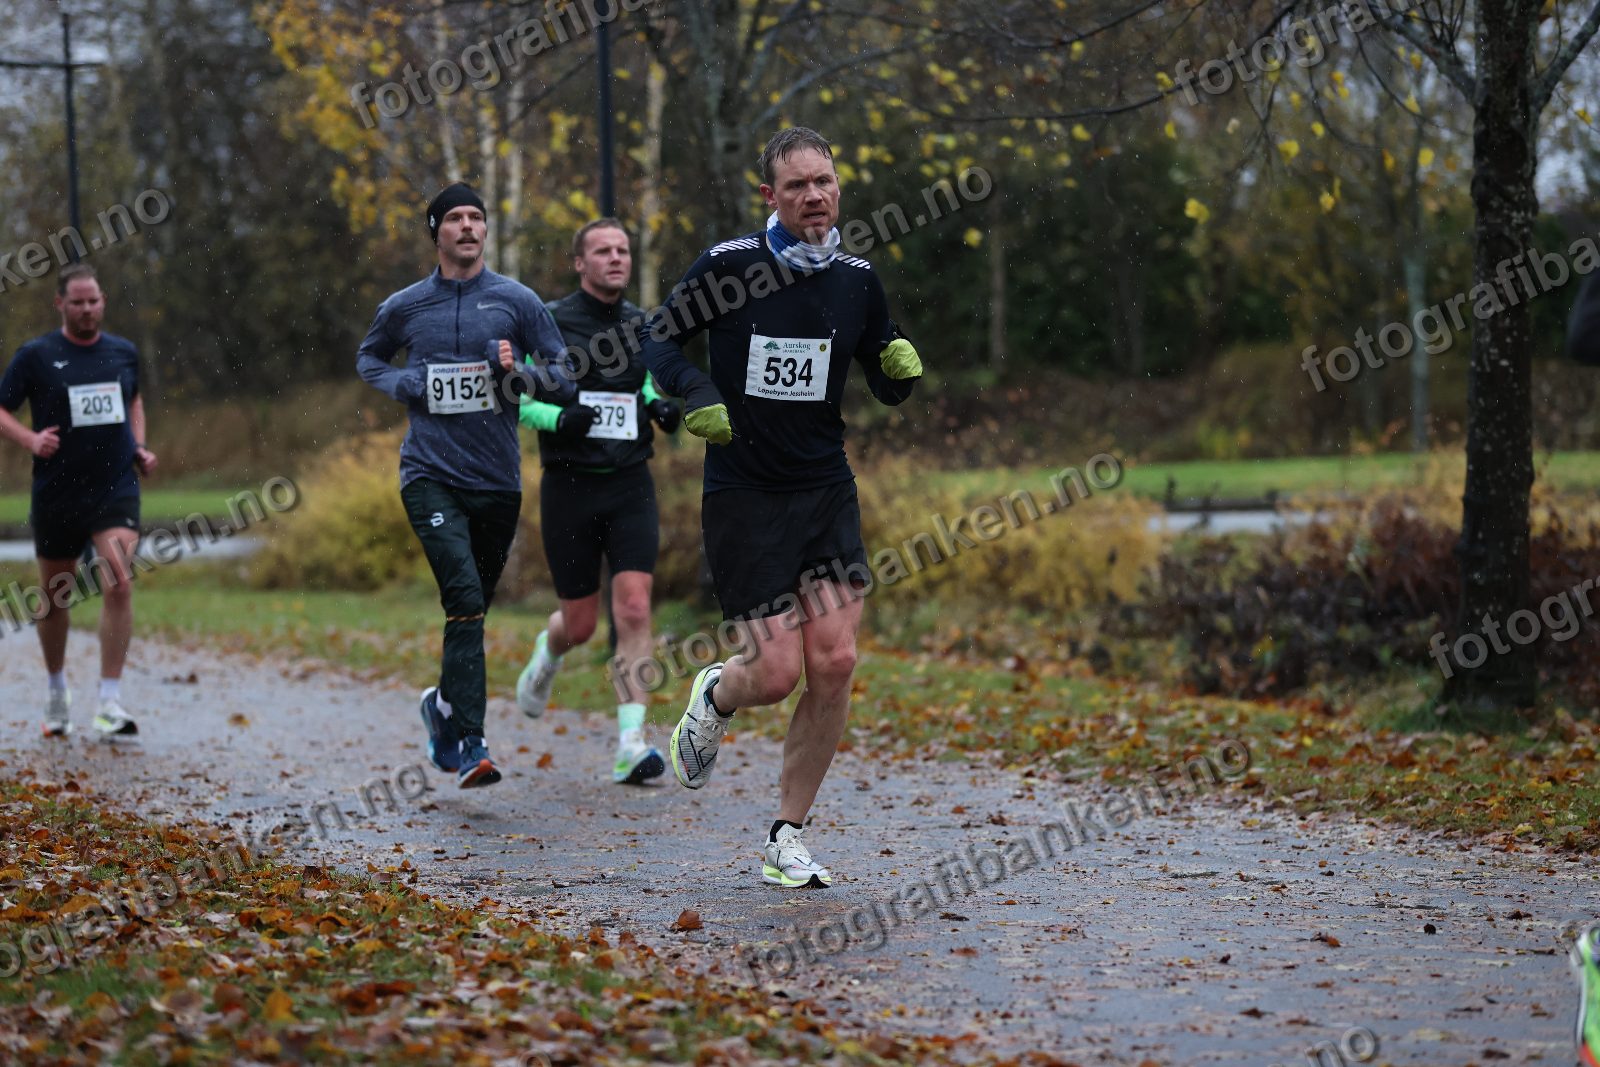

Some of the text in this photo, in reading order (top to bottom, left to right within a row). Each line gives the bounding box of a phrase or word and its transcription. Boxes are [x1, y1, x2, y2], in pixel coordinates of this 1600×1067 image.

[783, 341, 811, 350] Aurskog
[763, 356, 813, 387] 534
[432, 375, 488, 402] 9152
[757, 387, 789, 397] Løpebyen
[81, 395, 113, 416] 203
